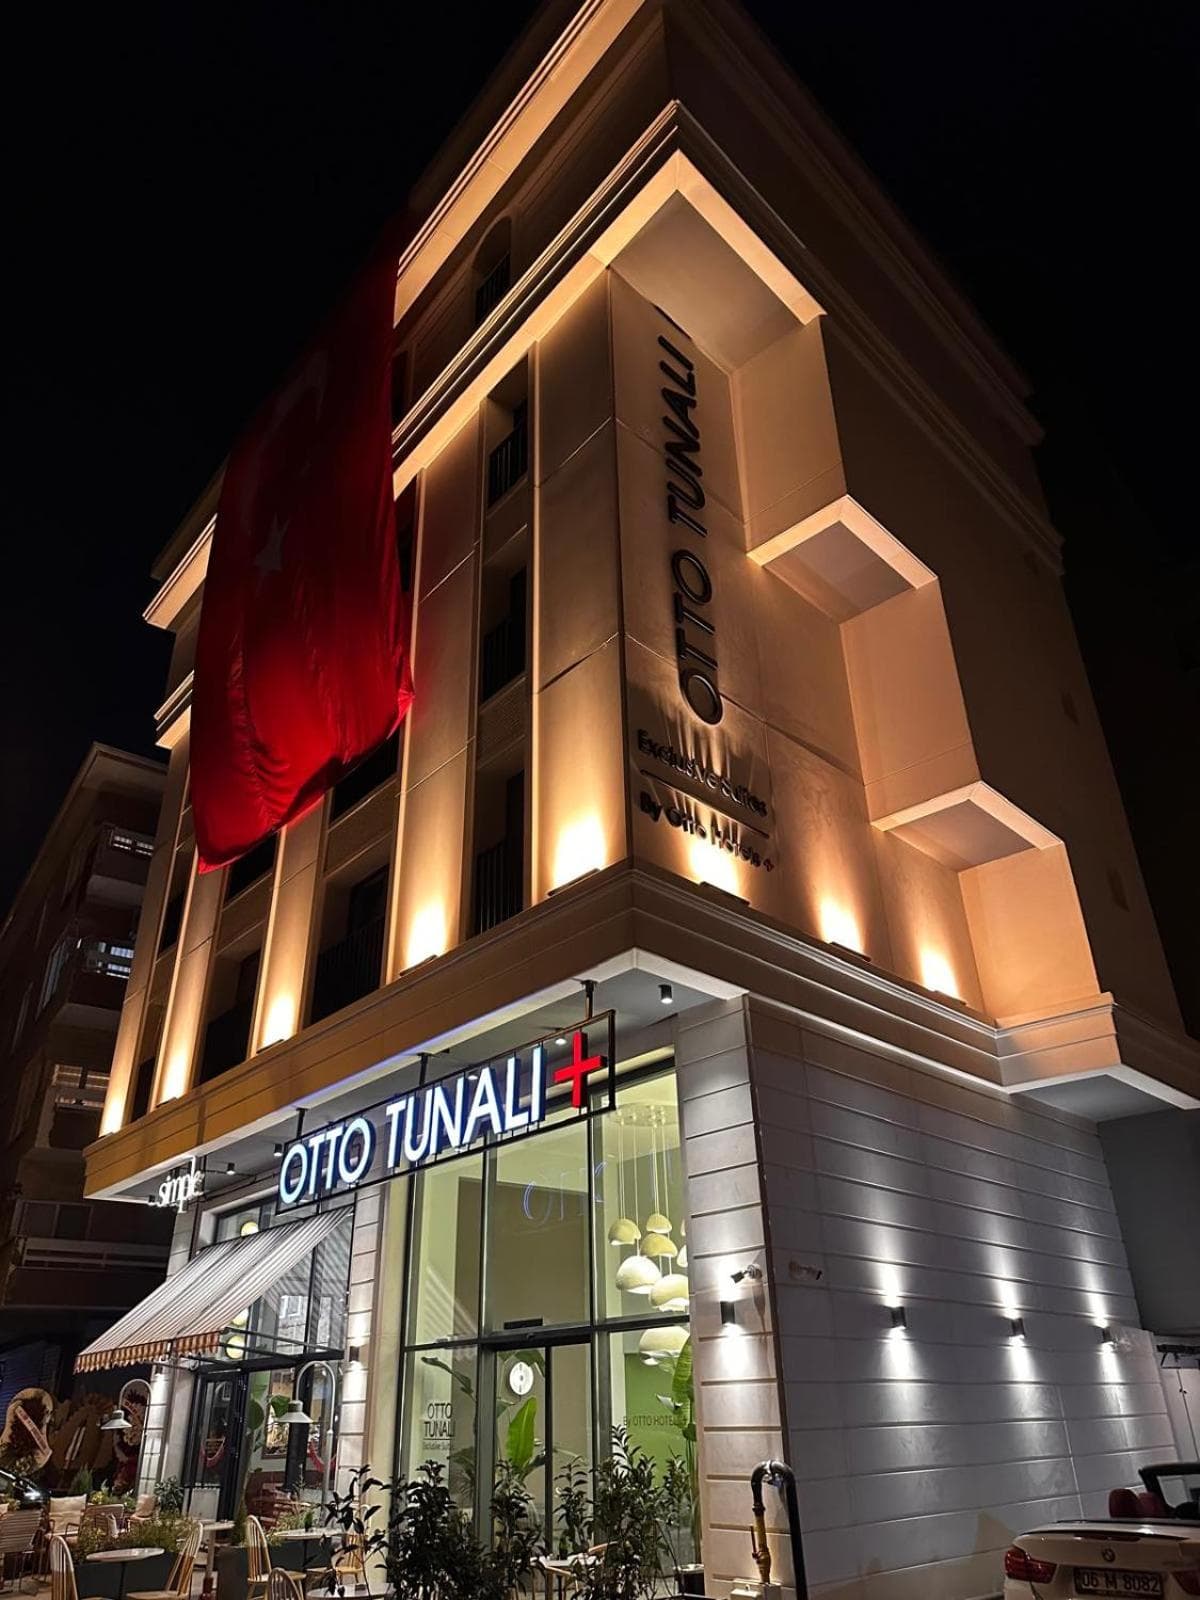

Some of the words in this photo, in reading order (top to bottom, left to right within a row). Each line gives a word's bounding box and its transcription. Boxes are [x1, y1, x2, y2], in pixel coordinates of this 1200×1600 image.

[658, 335, 709, 538] TUNALI
[671, 550, 724, 726] OTTO
[638, 729, 718, 789] Exclusive
[639, 791, 663, 822] By
[665, 806, 707, 840] Otto
[711, 823, 761, 868] Hotels
[279, 1117, 375, 1205] OTTO
[386, 1043, 546, 1170] TUNALI
[424, 1420, 456, 1438] TUNALI
[427, 1402, 453, 1419] OTTO
[633, 1415, 652, 1426] OTTO
